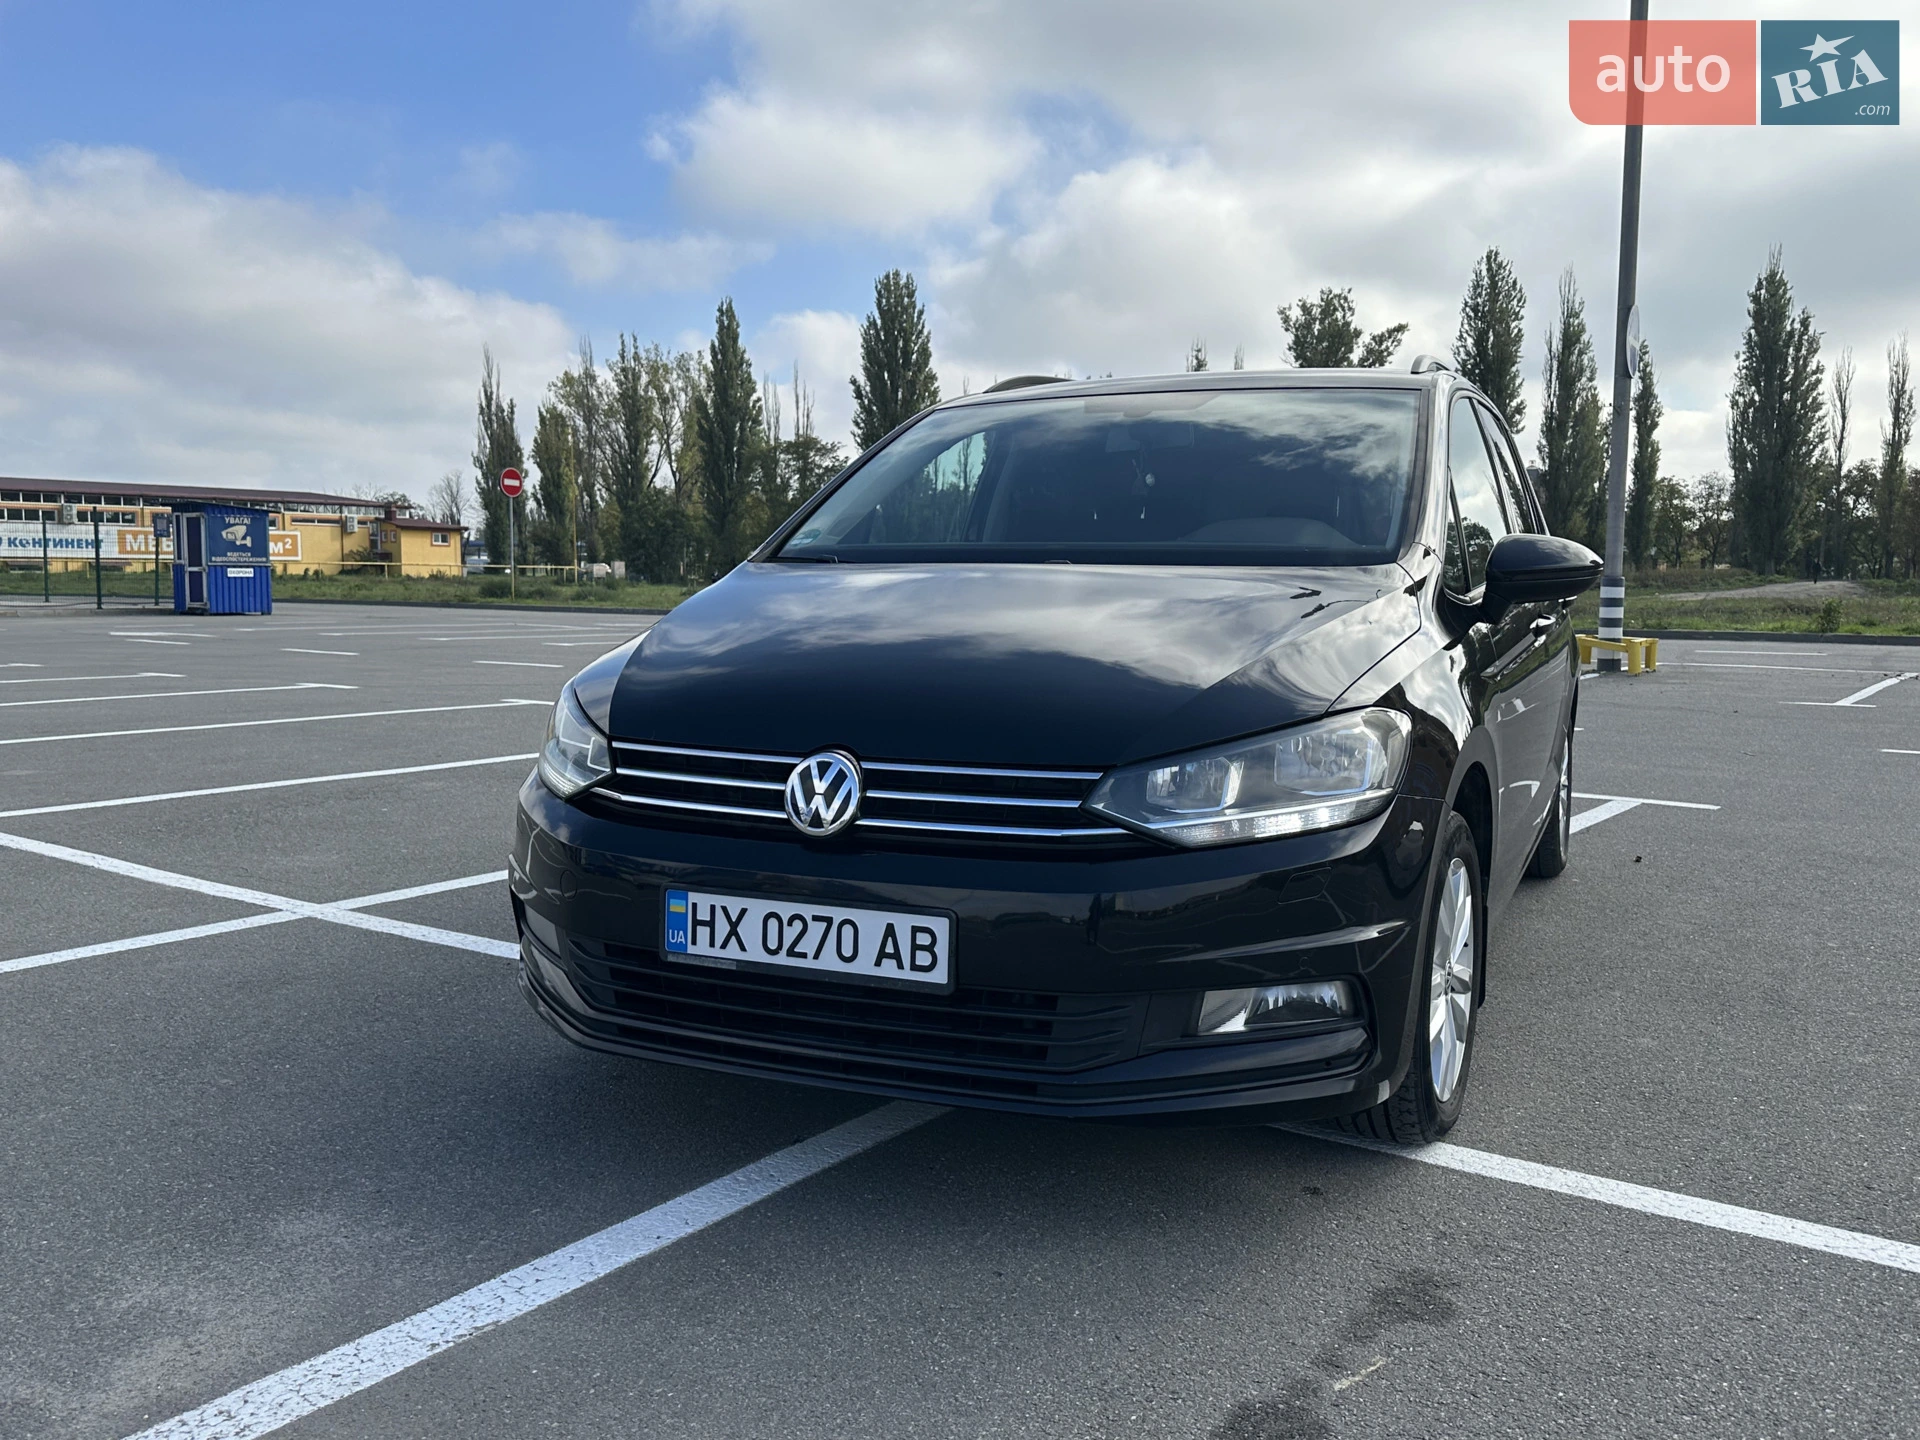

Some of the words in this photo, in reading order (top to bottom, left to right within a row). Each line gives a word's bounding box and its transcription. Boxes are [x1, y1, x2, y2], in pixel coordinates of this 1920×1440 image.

[224, 516, 251, 525] УВАГА!
[669, 929, 686, 945] UA
[690, 901, 749, 952] HX
[761, 911, 859, 963] 0270
[874, 922, 938, 973] AB
